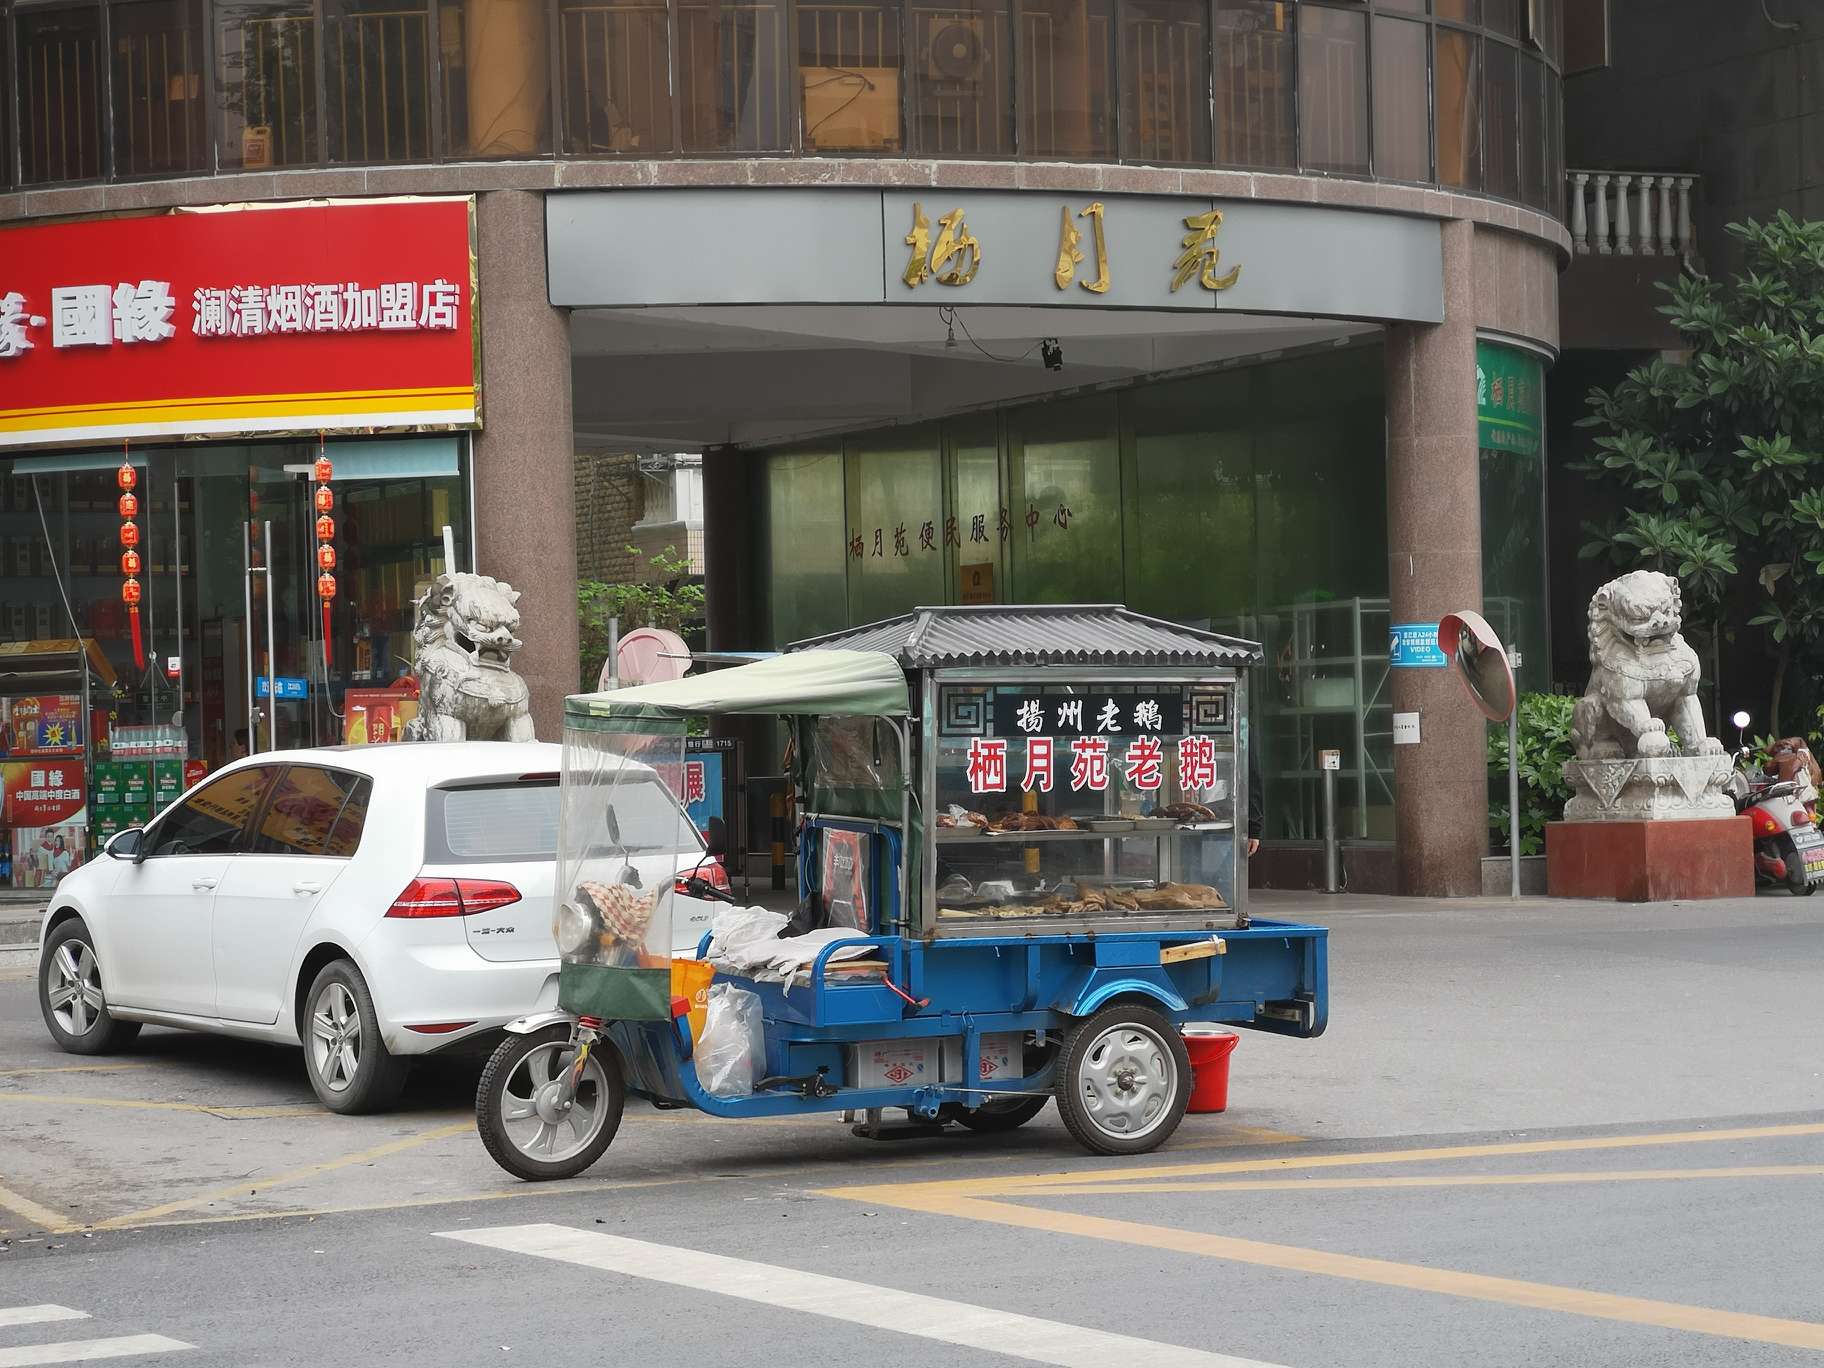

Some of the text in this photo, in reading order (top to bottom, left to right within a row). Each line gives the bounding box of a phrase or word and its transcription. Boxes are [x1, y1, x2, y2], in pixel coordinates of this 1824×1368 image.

[191, 278, 460, 336] 澜清烟酒加盟店
[850, 503, 1072, 561] 栖月苑便民服务中心
[967, 735, 1217, 793] 栖月苑老鹅
